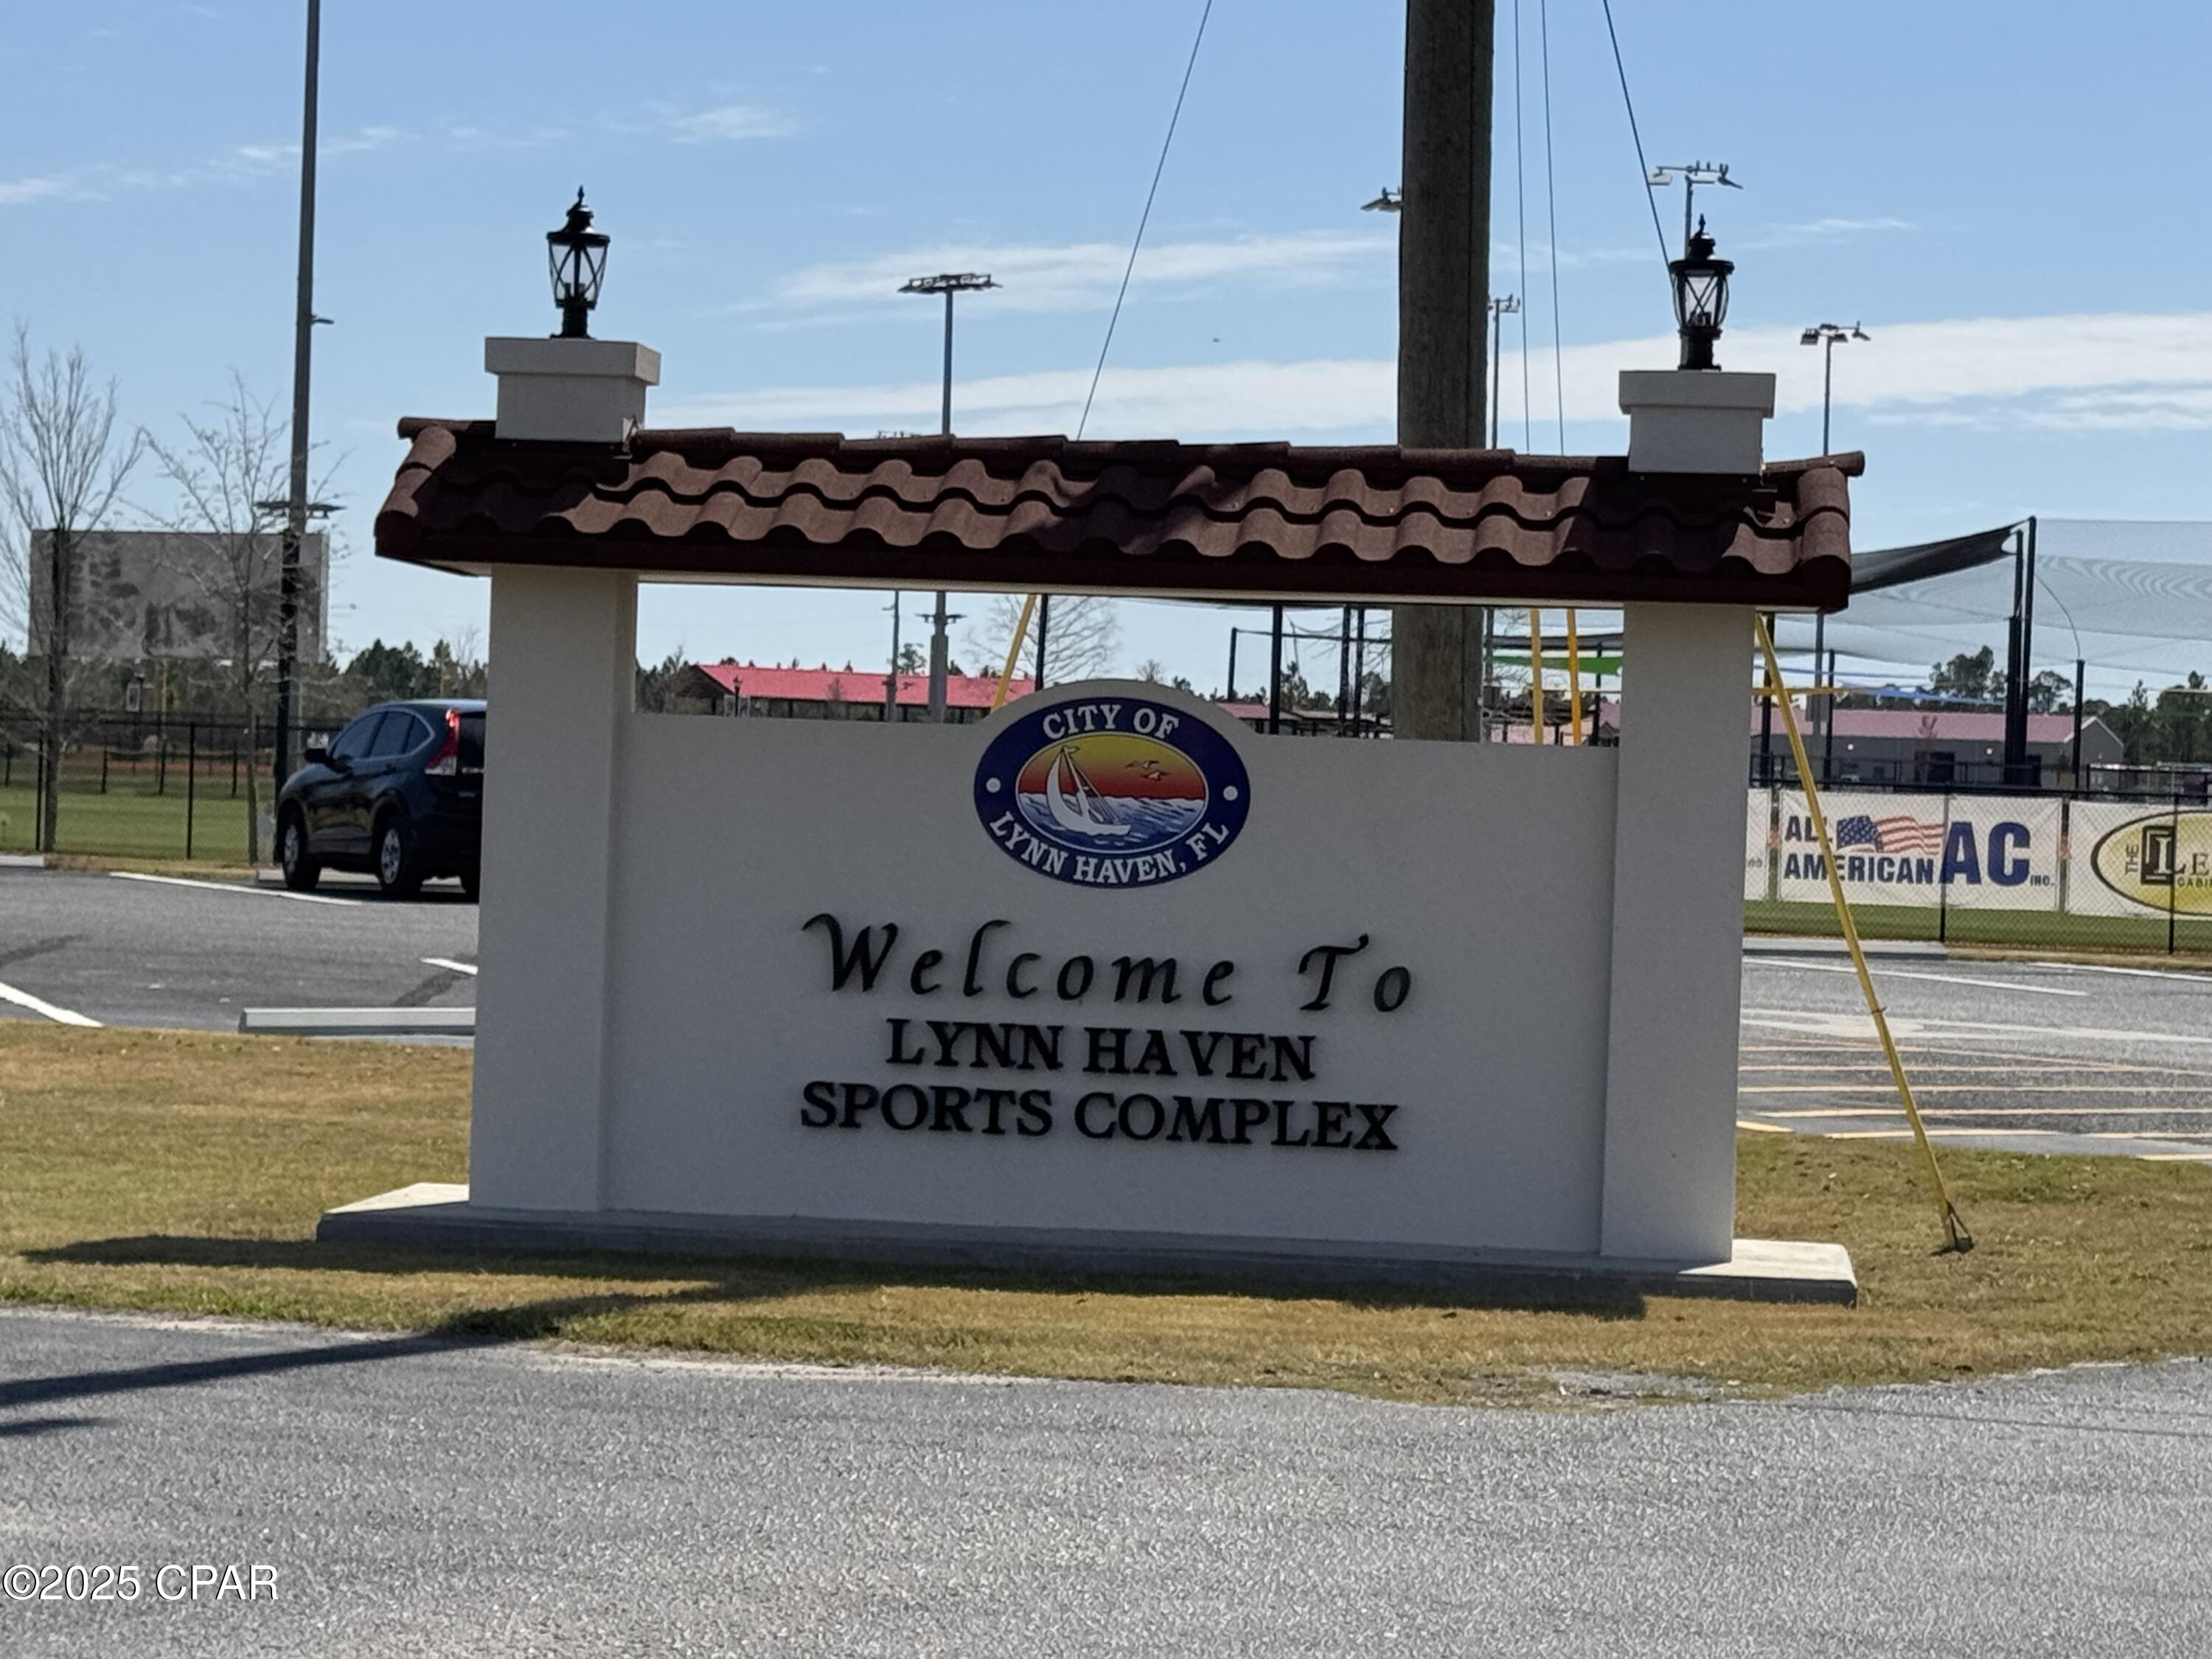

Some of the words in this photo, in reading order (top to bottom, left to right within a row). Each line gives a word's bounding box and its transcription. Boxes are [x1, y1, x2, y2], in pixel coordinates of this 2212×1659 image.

[1043, 704, 1121, 739] CITY
[1133, 708, 1180, 739] OF
[990, 811, 1068, 876] LYNN
[1073, 849, 1187, 885] HAVEN,
[1186, 821, 1230, 861] FL
[1783, 853, 1934, 885] AMERICAN
[1938, 821, 2031, 887] AC
[2125, 844, 2139, 875] THE
[801, 913, 1235, 1007] Welcome
[1298, 933, 1412, 1013] To
[886, 1018, 1065, 1071] LYNN
[1082, 1027, 1316, 1082] HAVEN
[800, 1081, 1053, 1137] SPORTS
[1073, 1091, 1399, 1151] COMPLEX
